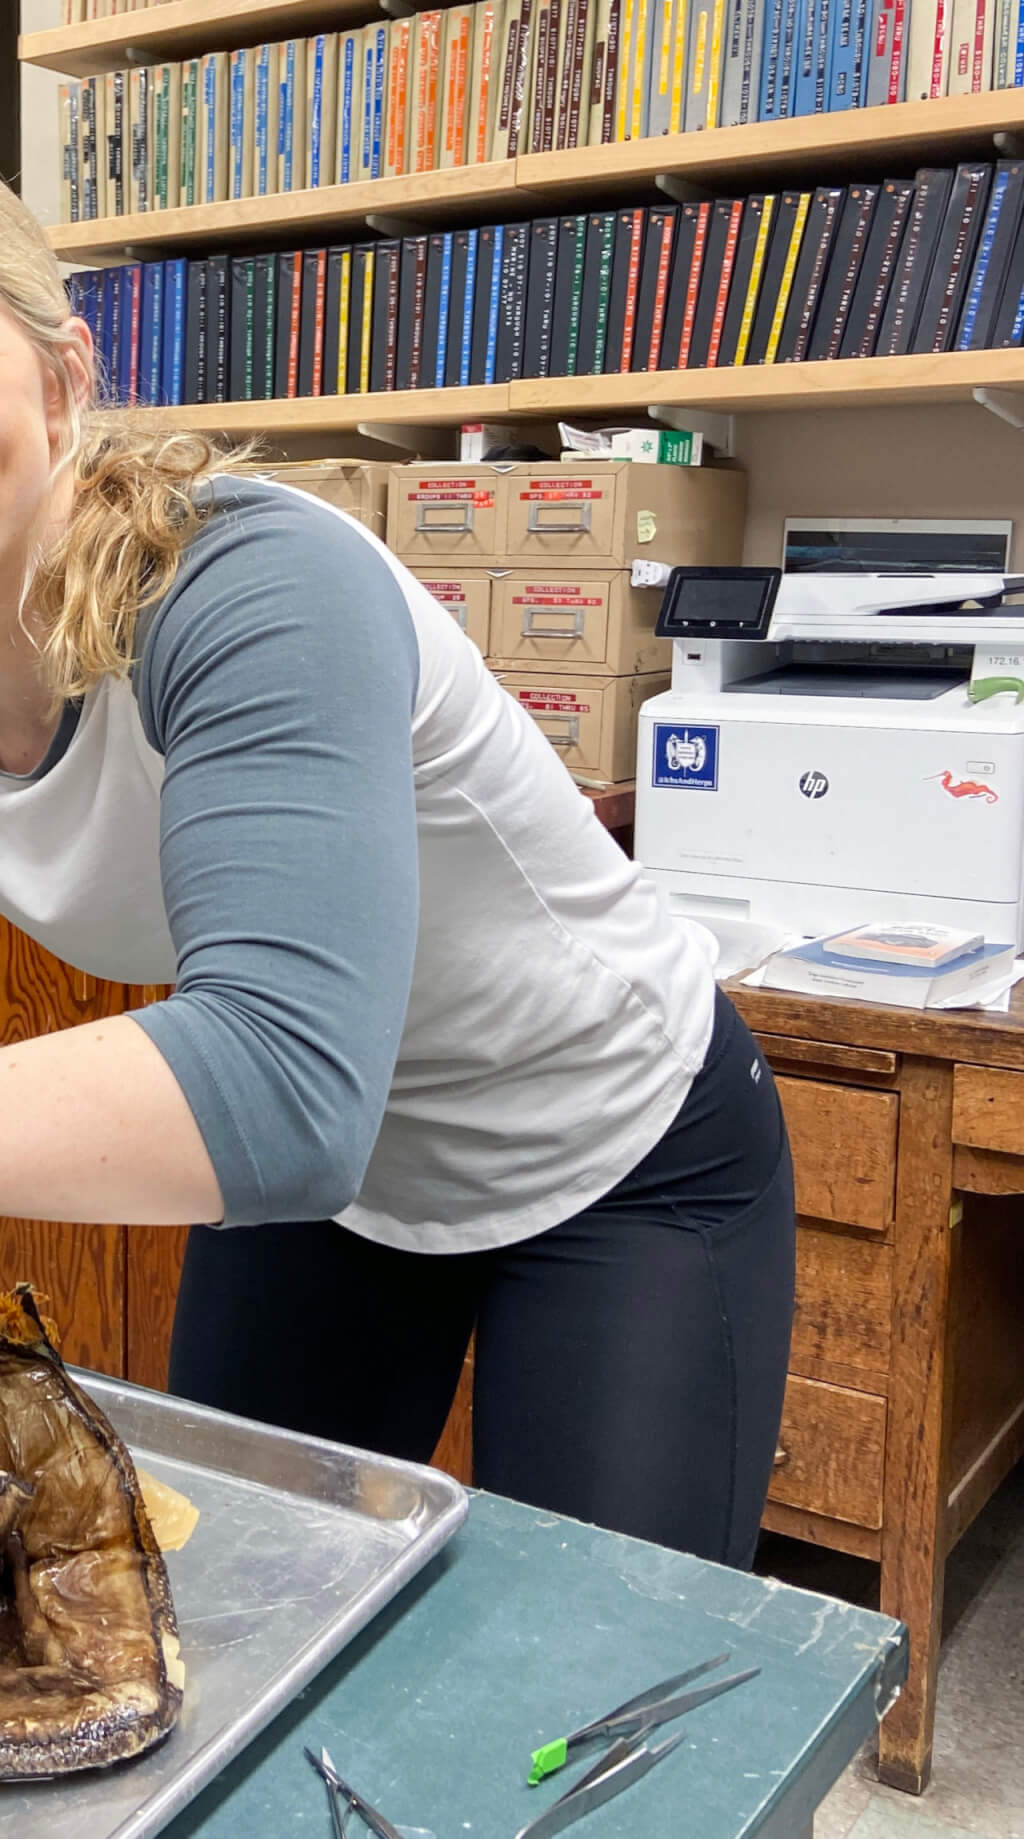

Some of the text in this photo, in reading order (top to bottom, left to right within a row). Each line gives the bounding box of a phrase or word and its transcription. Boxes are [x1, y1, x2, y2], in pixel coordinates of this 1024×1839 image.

[894, 21, 902, 40] THRU
[572, 69, 580, 101] THROUGH
[605, 68, 613, 100] THROUGH
[917, 184, 927, 206] 2011
[890, 219, 900, 237] SIO
[986, 216, 996, 236] SIO
[726, 239, 734, 256] SIO
[820, 231, 829, 248] SIO
[904, 238, 916, 271] 11-301
[939, 206, 972, 325] SIO 11-401 THRU SIO
[682, 240, 702, 342] SIO THRU SIO
[899, 279, 909, 303] THRU
[973, 269, 984, 293] THRU
[807, 283, 816, 306] THRU
[839, 288, 849, 312] THRU
[873, 284, 884, 307] THRU
[716, 301, 724, 322] THRU
[894, 307, 903, 325] SIO
[967, 297, 978, 316] SIO
[833, 316, 842, 334] SIO
[867, 313, 876, 329] SIO
[529, 692, 572, 701] COLLECTION
[800, 771, 828, 799] hp
